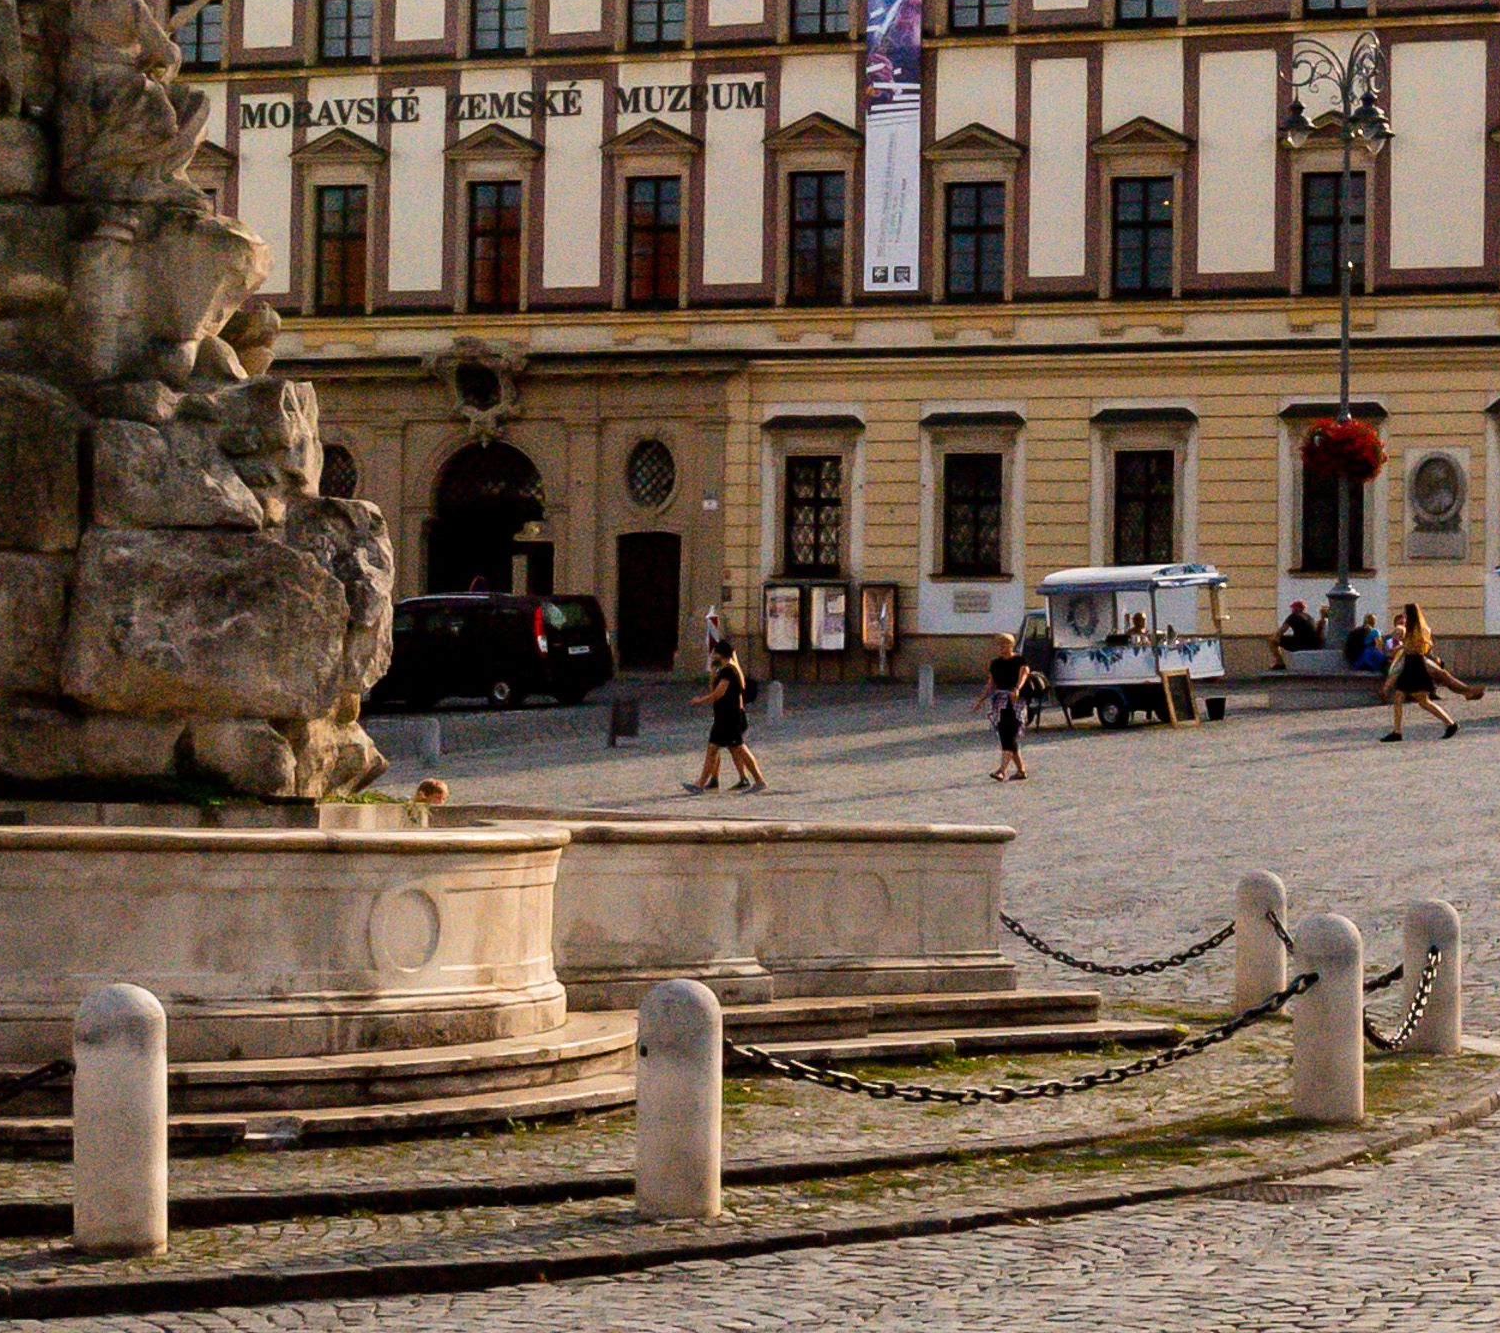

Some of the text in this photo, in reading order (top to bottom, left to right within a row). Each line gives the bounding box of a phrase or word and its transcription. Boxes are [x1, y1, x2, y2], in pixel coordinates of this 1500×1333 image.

[240, 81, 766, 129] MORAVSKÉ ZEMSKÉ MUZEUM
